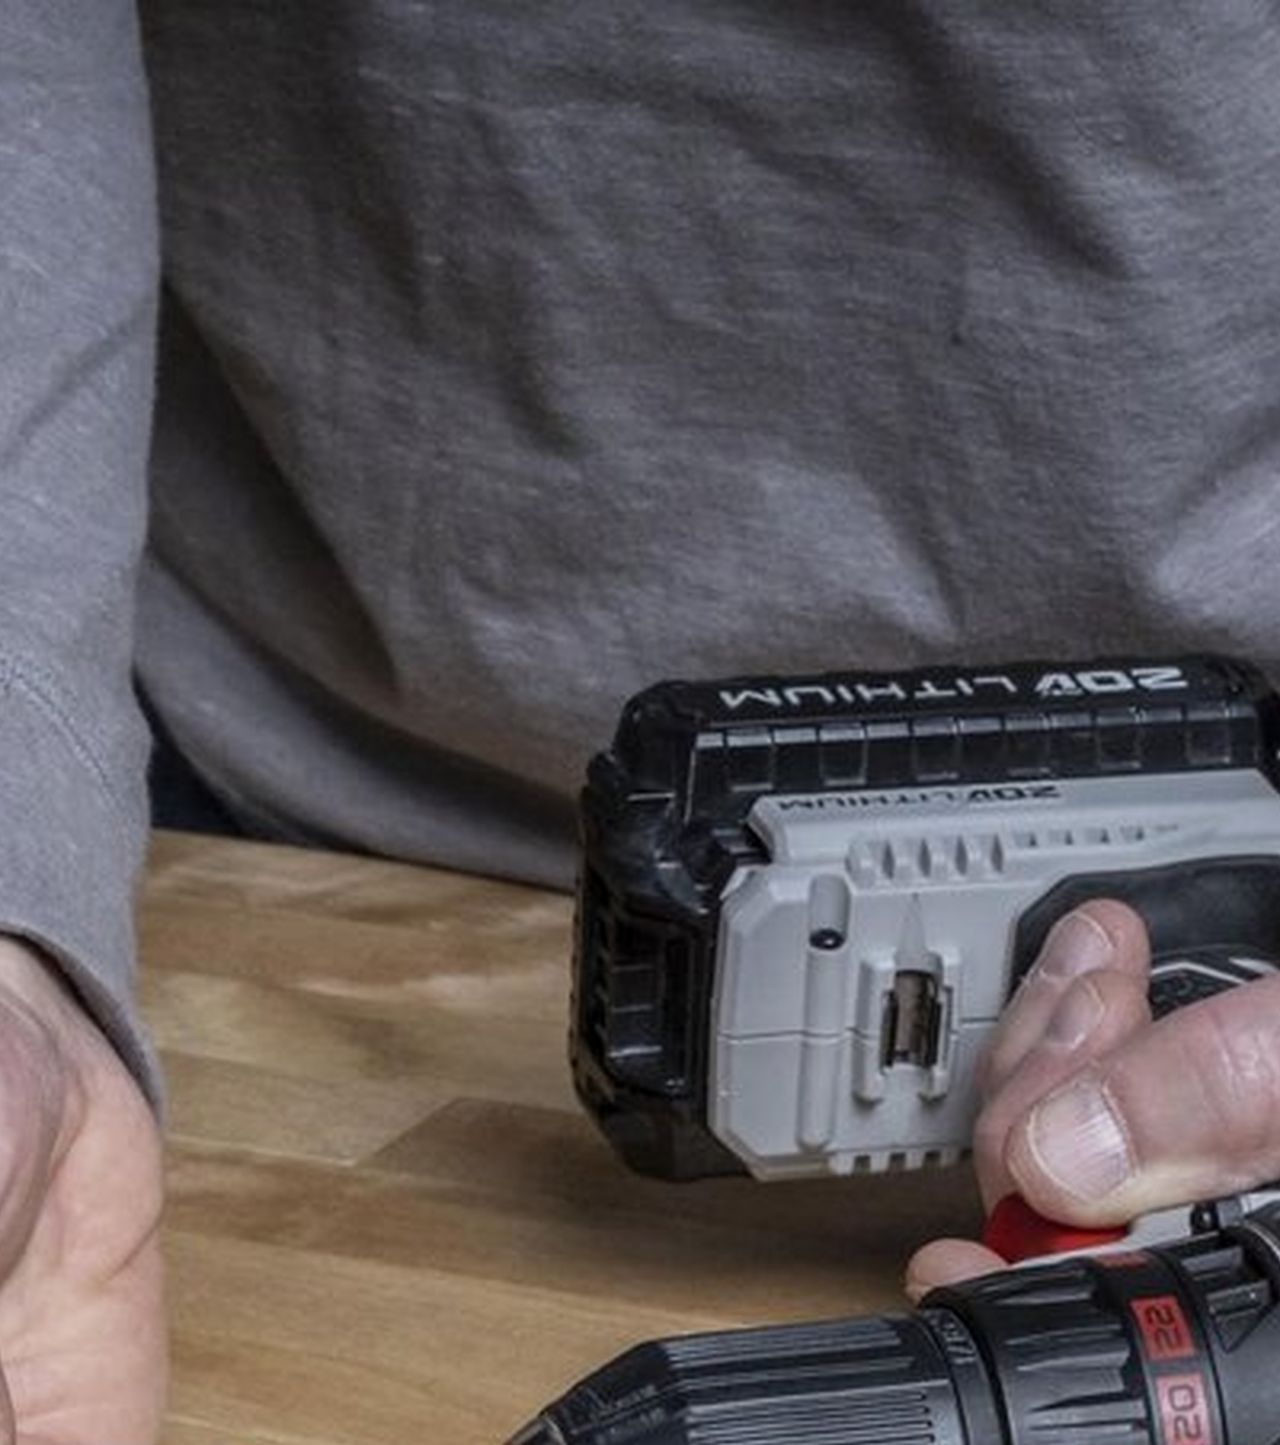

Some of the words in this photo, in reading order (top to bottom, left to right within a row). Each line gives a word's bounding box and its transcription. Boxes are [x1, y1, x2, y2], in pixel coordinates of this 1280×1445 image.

[720, 675, 1018, 709] LITHIUM
[776, 788, 963, 811] LITHIUM
[1145, 1304, 1183, 1353] 22
[1167, 1383, 1203, 1442] 20
